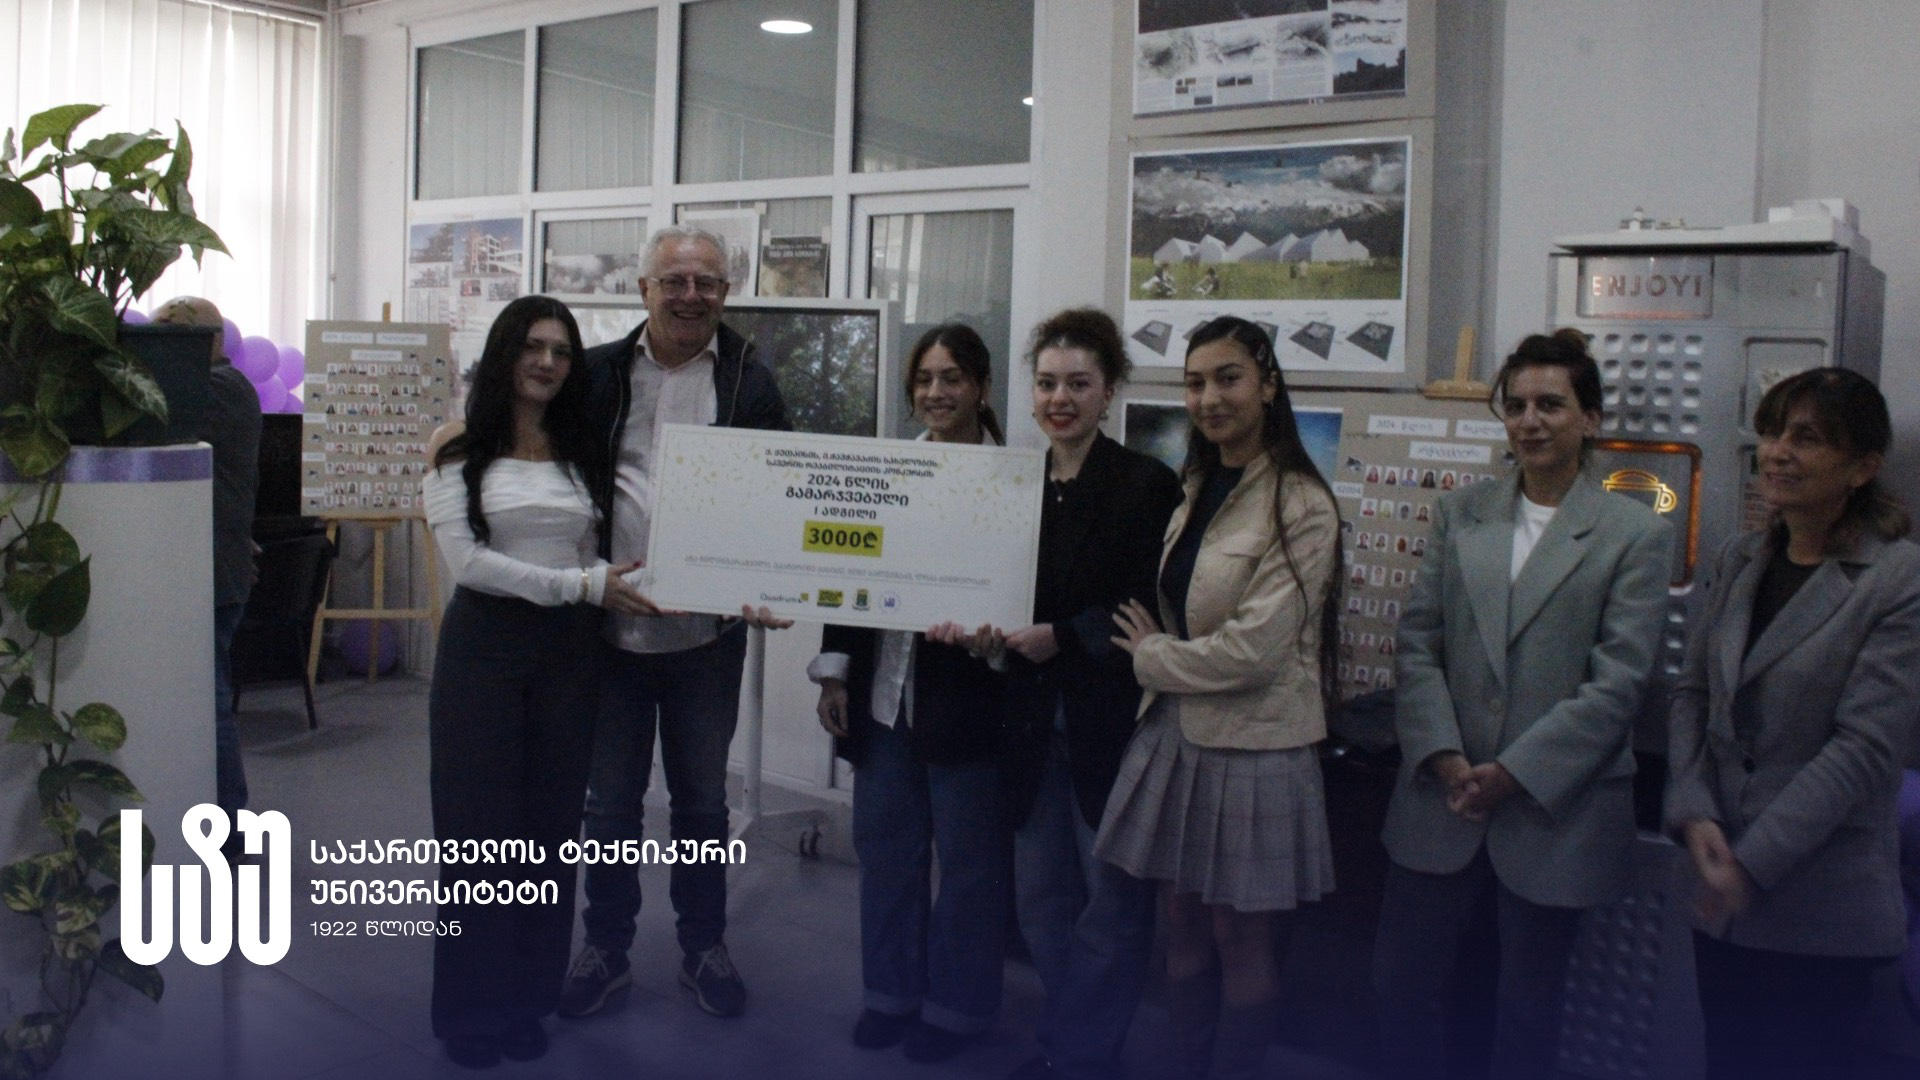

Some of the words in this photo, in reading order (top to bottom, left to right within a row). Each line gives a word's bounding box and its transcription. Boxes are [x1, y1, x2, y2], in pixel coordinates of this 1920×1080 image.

[807, 473, 841, 487] 2024
[844, 476, 890, 491] წლის
[785, 486, 910, 507] გამარჯვებული
[821, 506, 878, 520] ადგილი
